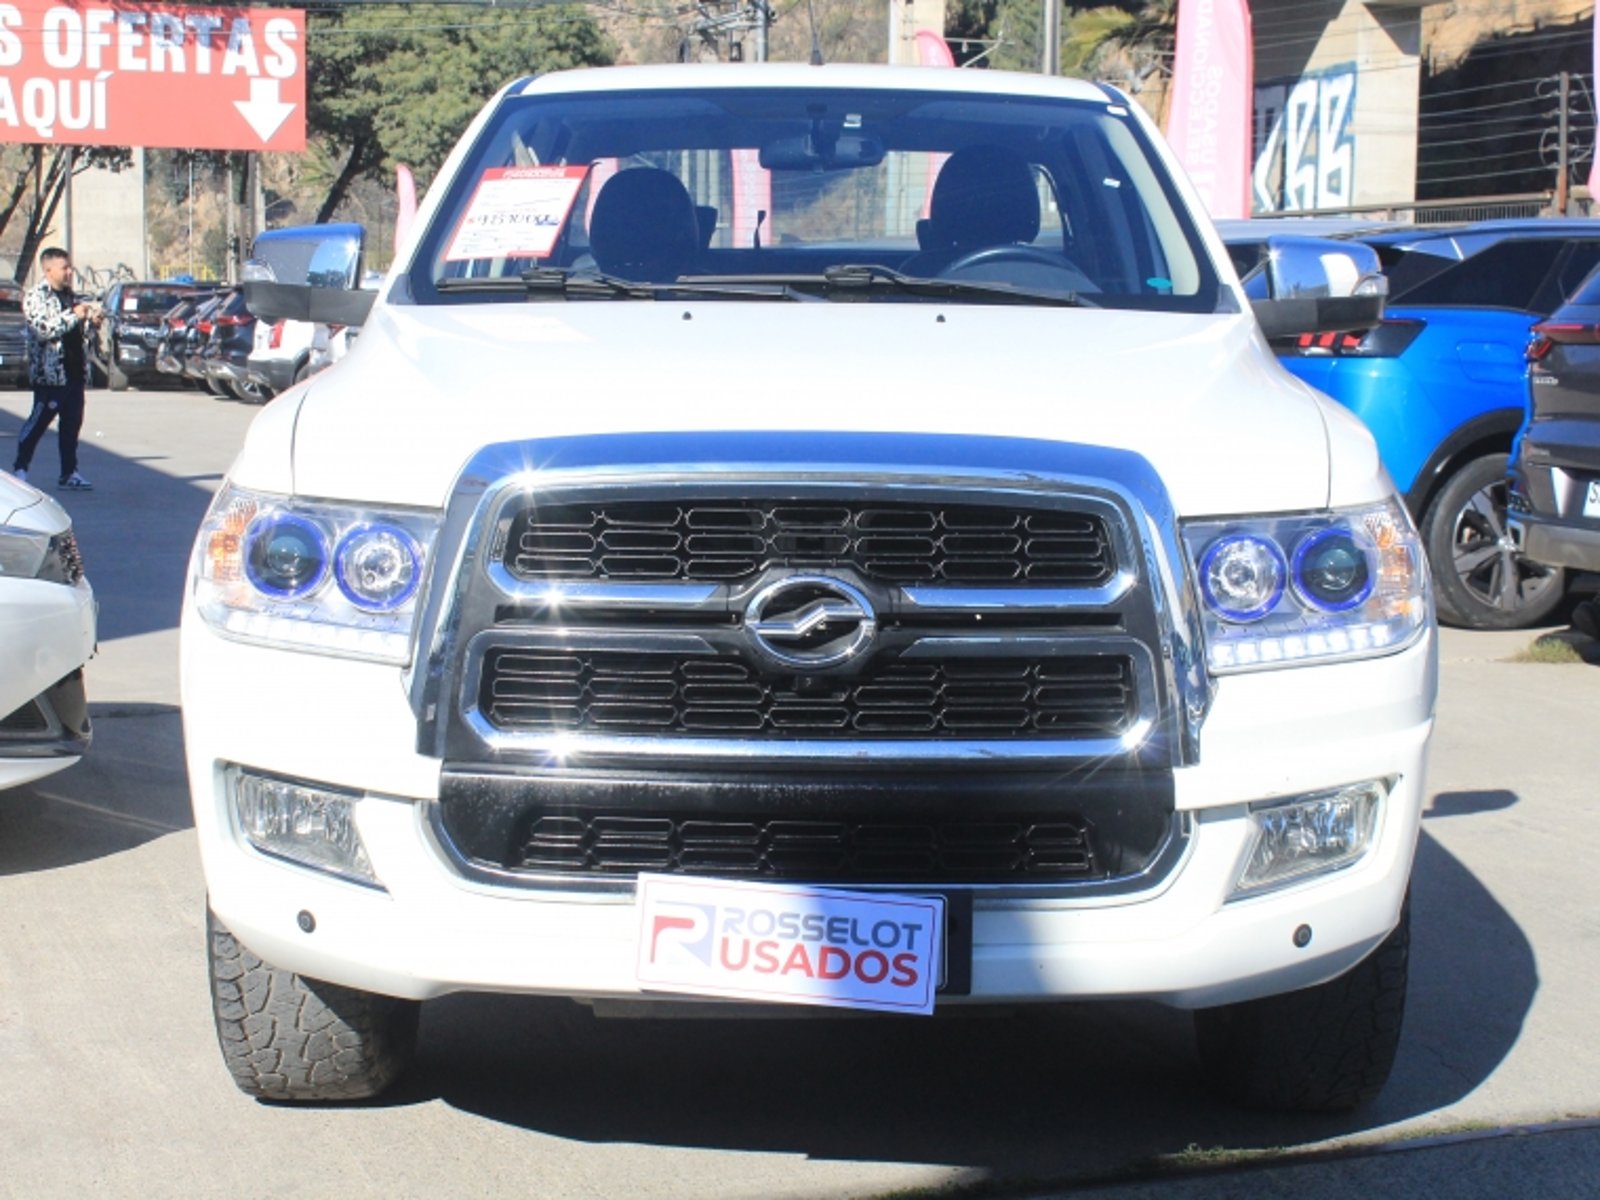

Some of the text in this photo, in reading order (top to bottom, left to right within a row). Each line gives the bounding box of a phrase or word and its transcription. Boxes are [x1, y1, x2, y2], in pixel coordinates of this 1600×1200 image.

[42, 6, 298, 78] OFERTAS
[720, 907, 922, 950] ROSSELOT
[719, 937, 918, 987] USADOS
